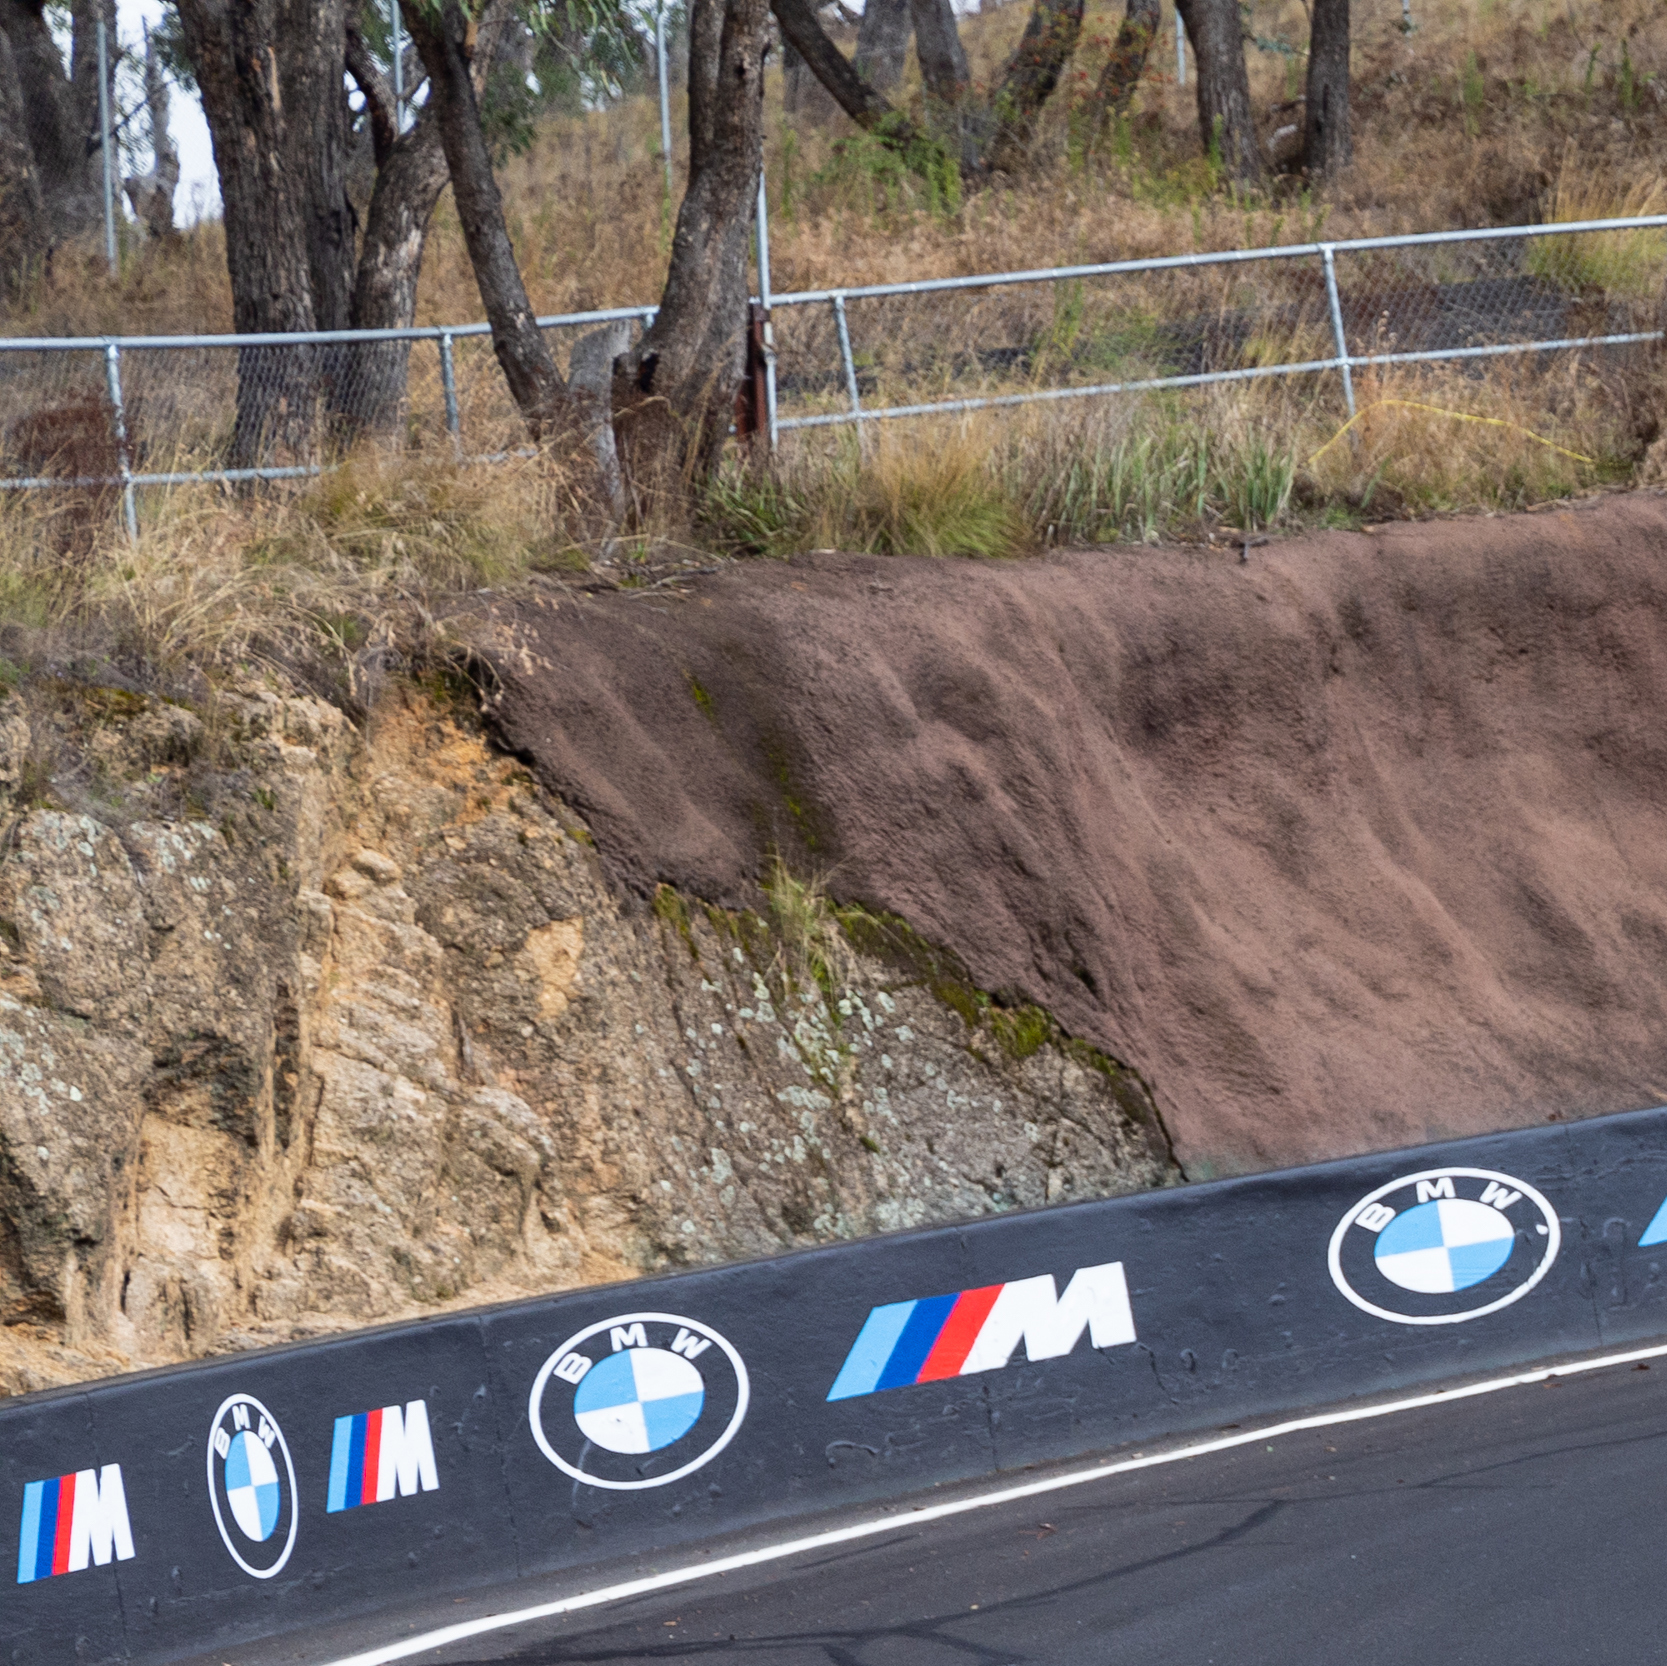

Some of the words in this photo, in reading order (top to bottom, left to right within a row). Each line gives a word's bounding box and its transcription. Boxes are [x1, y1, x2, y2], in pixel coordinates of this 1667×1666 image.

[1355, 1177, 1523, 1232] BMW
[553, 1322, 712, 1385] BMW
[213, 1403, 276, 1460] BMW
